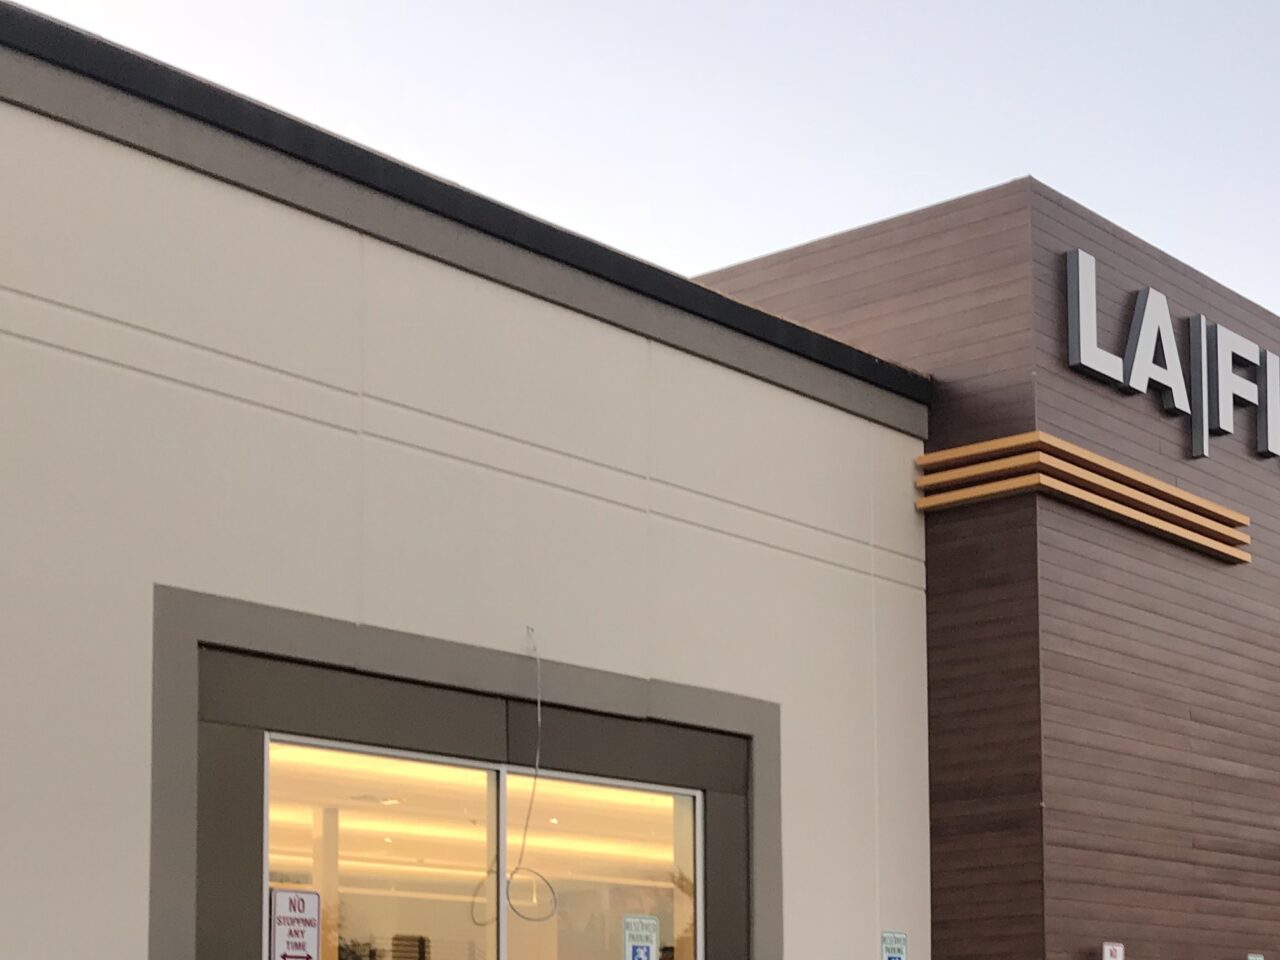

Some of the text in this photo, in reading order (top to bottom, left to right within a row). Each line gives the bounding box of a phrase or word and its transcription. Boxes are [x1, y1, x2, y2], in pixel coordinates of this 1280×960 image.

[288, 897, 306, 914] NO
[276, 916, 317, 929] STOPPING
[287, 929, 305, 939] ANY
[285, 941, 307, 952] TIME
